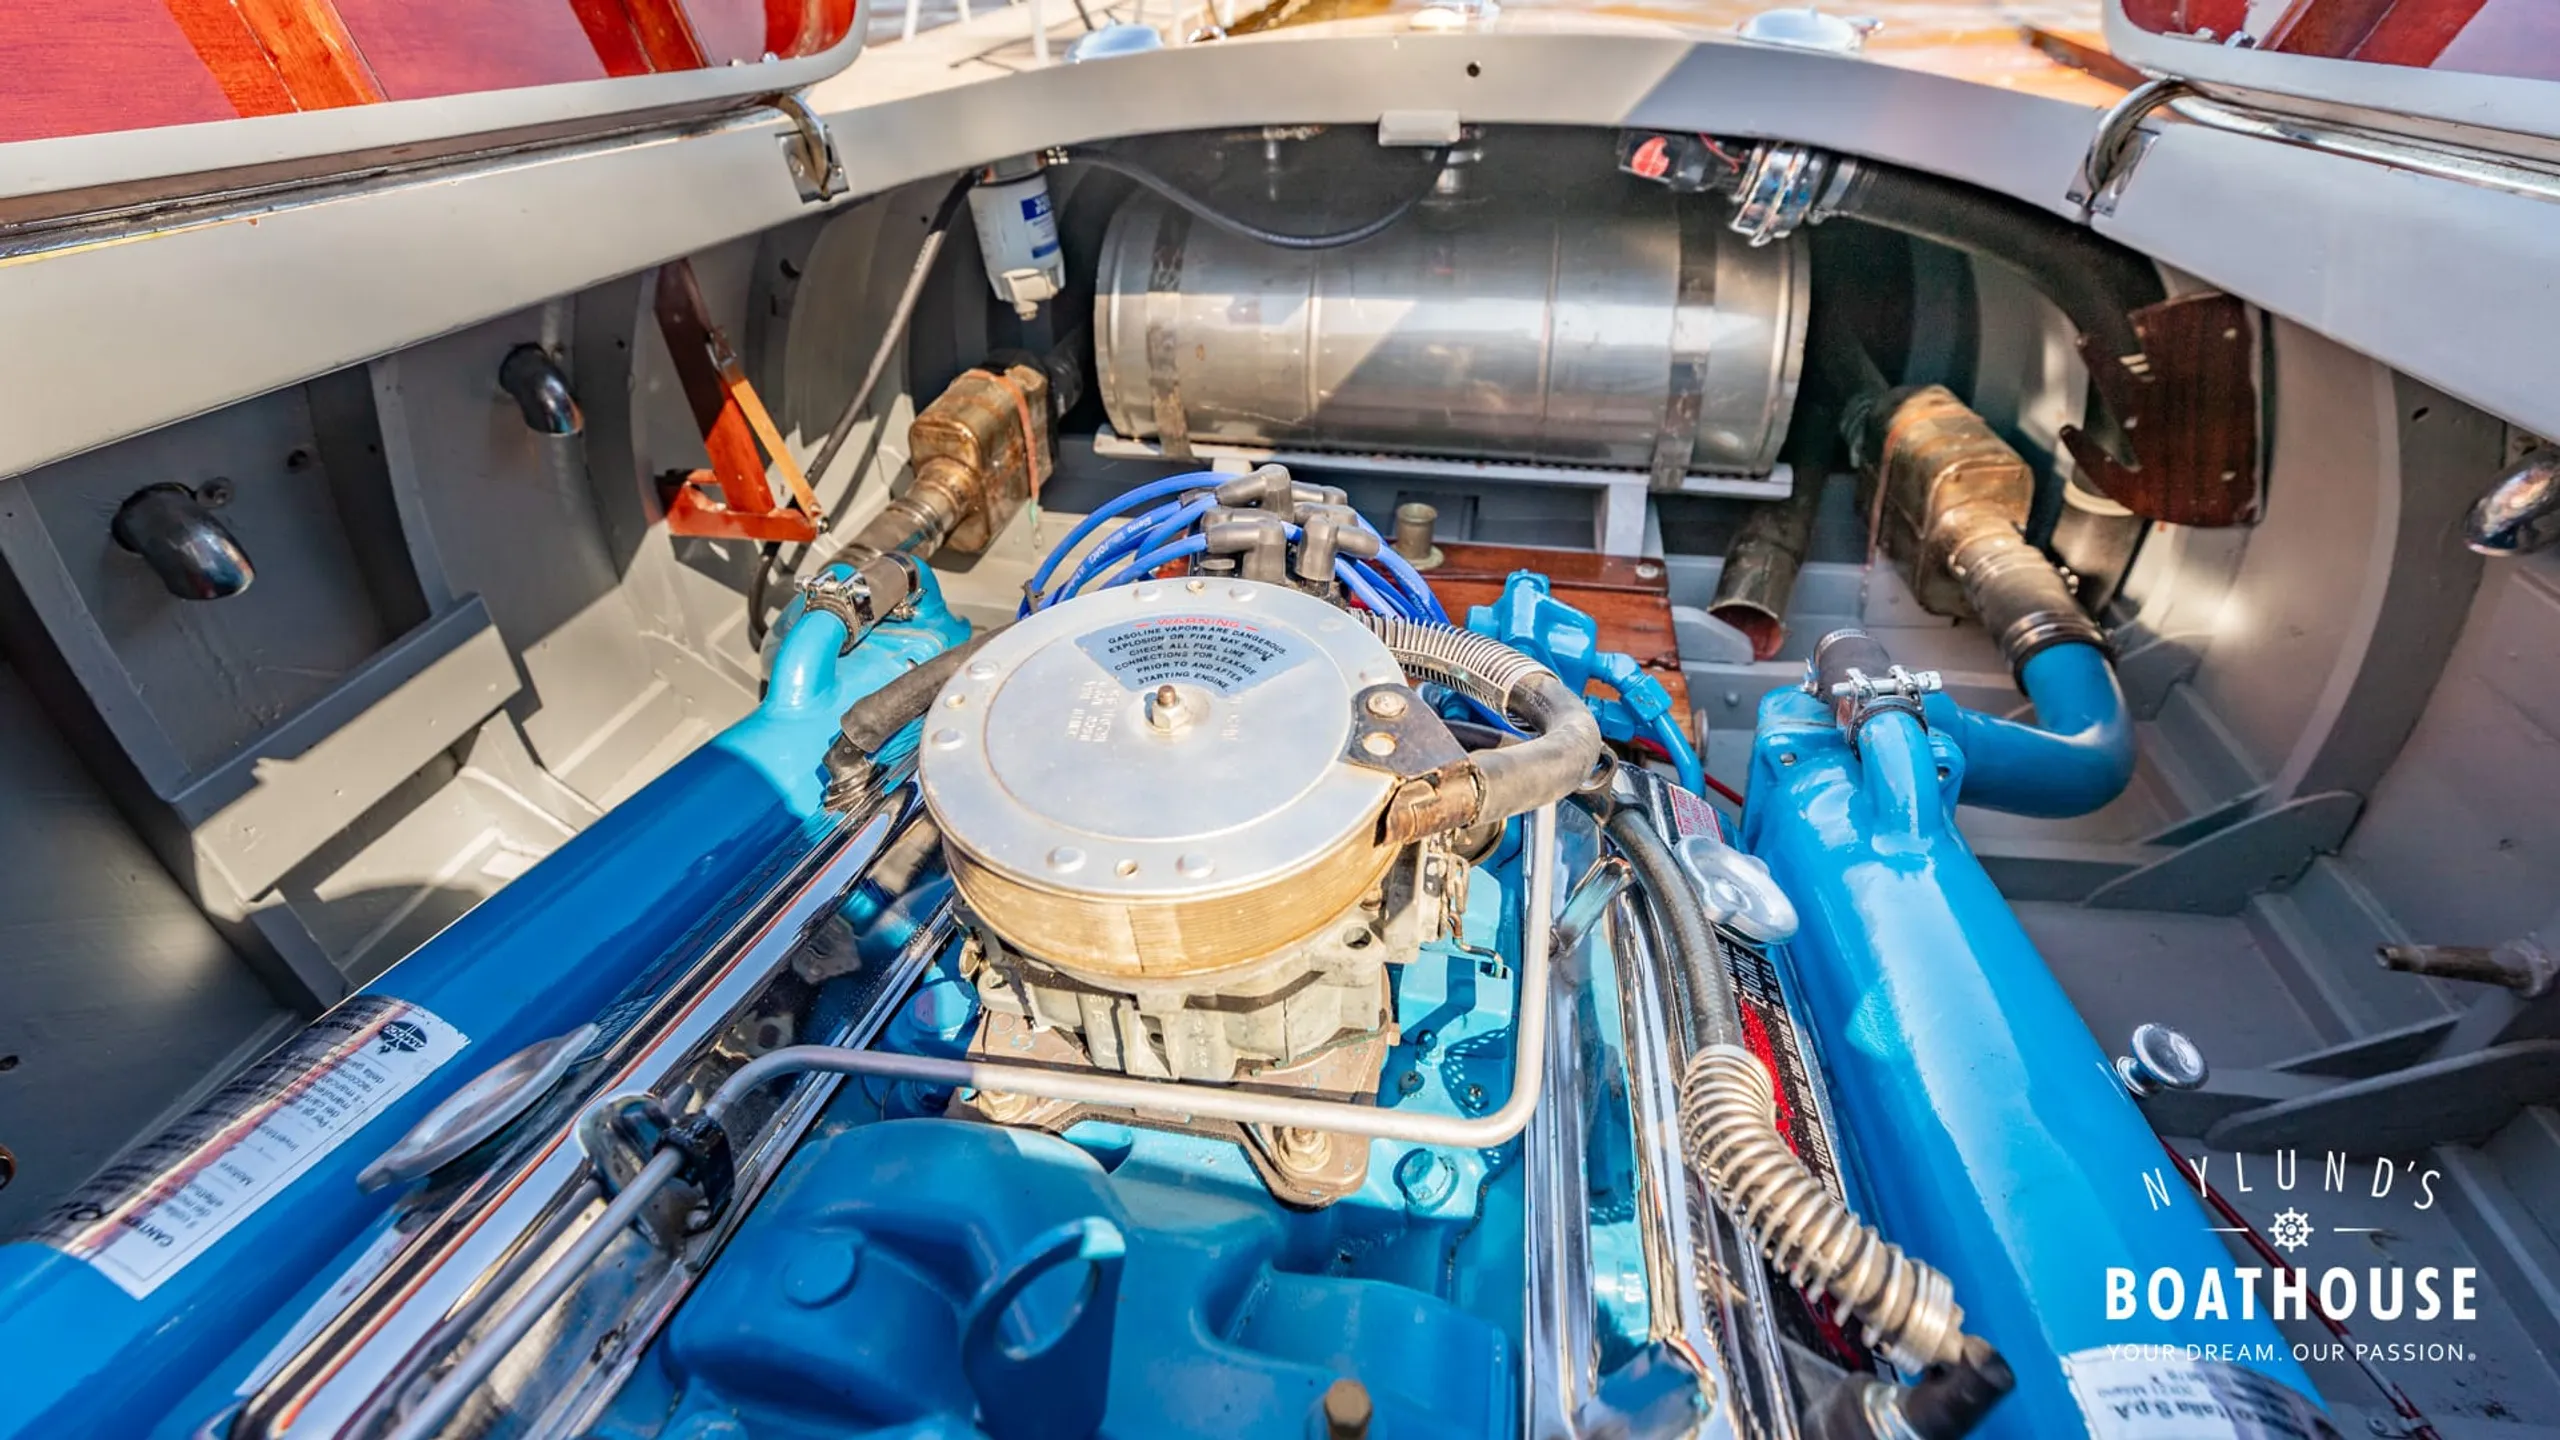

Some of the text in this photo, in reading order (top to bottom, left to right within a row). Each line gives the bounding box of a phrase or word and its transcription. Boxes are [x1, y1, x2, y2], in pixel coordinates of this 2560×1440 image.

[1157, 617, 1240, 628] WARNING
[1107, 627, 1161, 644] GASOLINE
[1164, 624, 1205, 633] VAPORS
[1208, 625, 1229, 635] ARE
[1108, 635, 1165, 654] EXPLOSION
[1189, 633, 1214, 641] FIRE
[1220, 636, 1240, 645] MAY
[1129, 642, 1246, 659] CHECK ALL FUEL LINE
[1114, 651, 1258, 676] CONNECTIONS FOR LEAKAGE
[1136, 662, 1170, 674] PRIOR
[1191, 662, 1214, 671] AND
[1213, 667, 1243, 684] AFTER
[1137, 671, 1190, 685] STARTING
